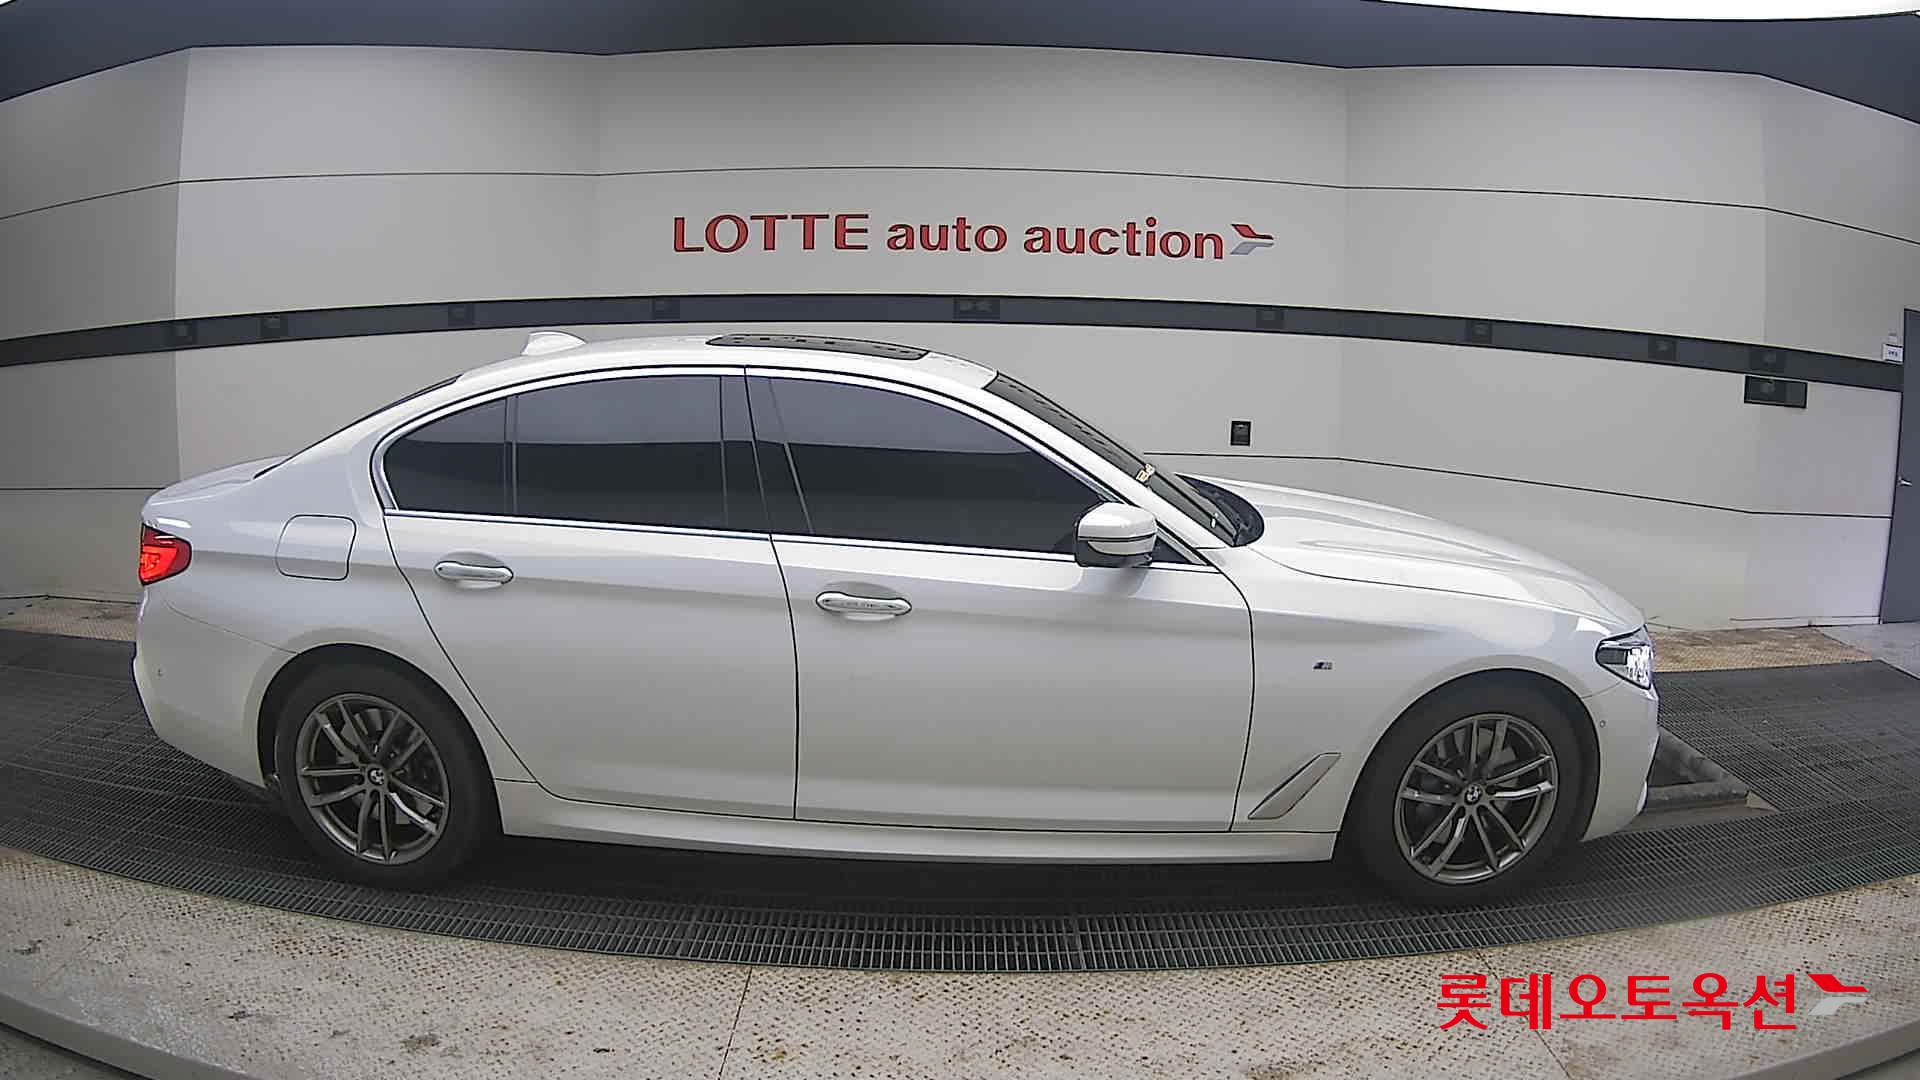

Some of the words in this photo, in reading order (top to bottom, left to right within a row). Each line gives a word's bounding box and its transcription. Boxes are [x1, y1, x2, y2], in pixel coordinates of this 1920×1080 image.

[673, 213, 869, 254] LOTTE
[885, 215, 1008, 254] auto
[1023, 216, 1225, 260] auction
